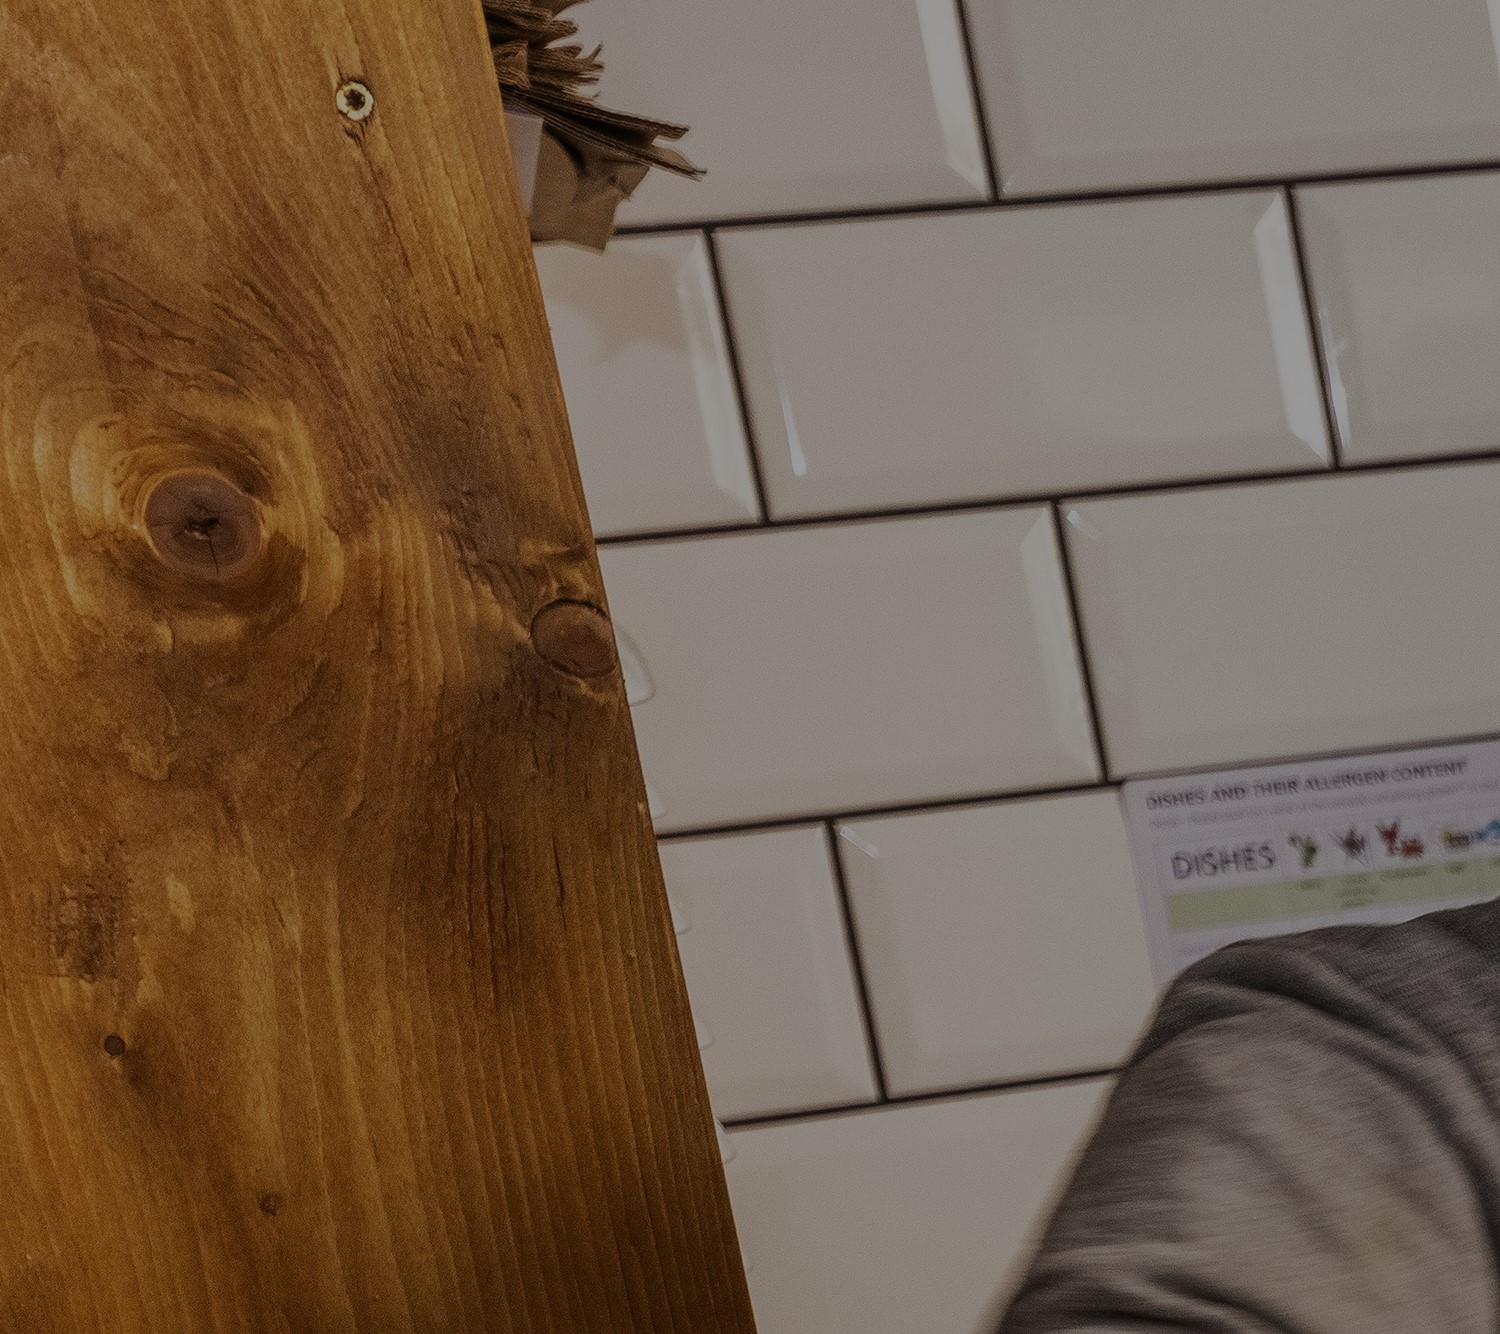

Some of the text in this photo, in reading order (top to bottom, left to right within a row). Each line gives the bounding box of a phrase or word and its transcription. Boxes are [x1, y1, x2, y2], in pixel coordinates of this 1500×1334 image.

[1146, 789, 1206, 810] DISHES
[1210, 785, 1247, 802] AND
[1390, 760, 1468, 783] CONTENT
[1170, 844, 1275, 881] DISHES
